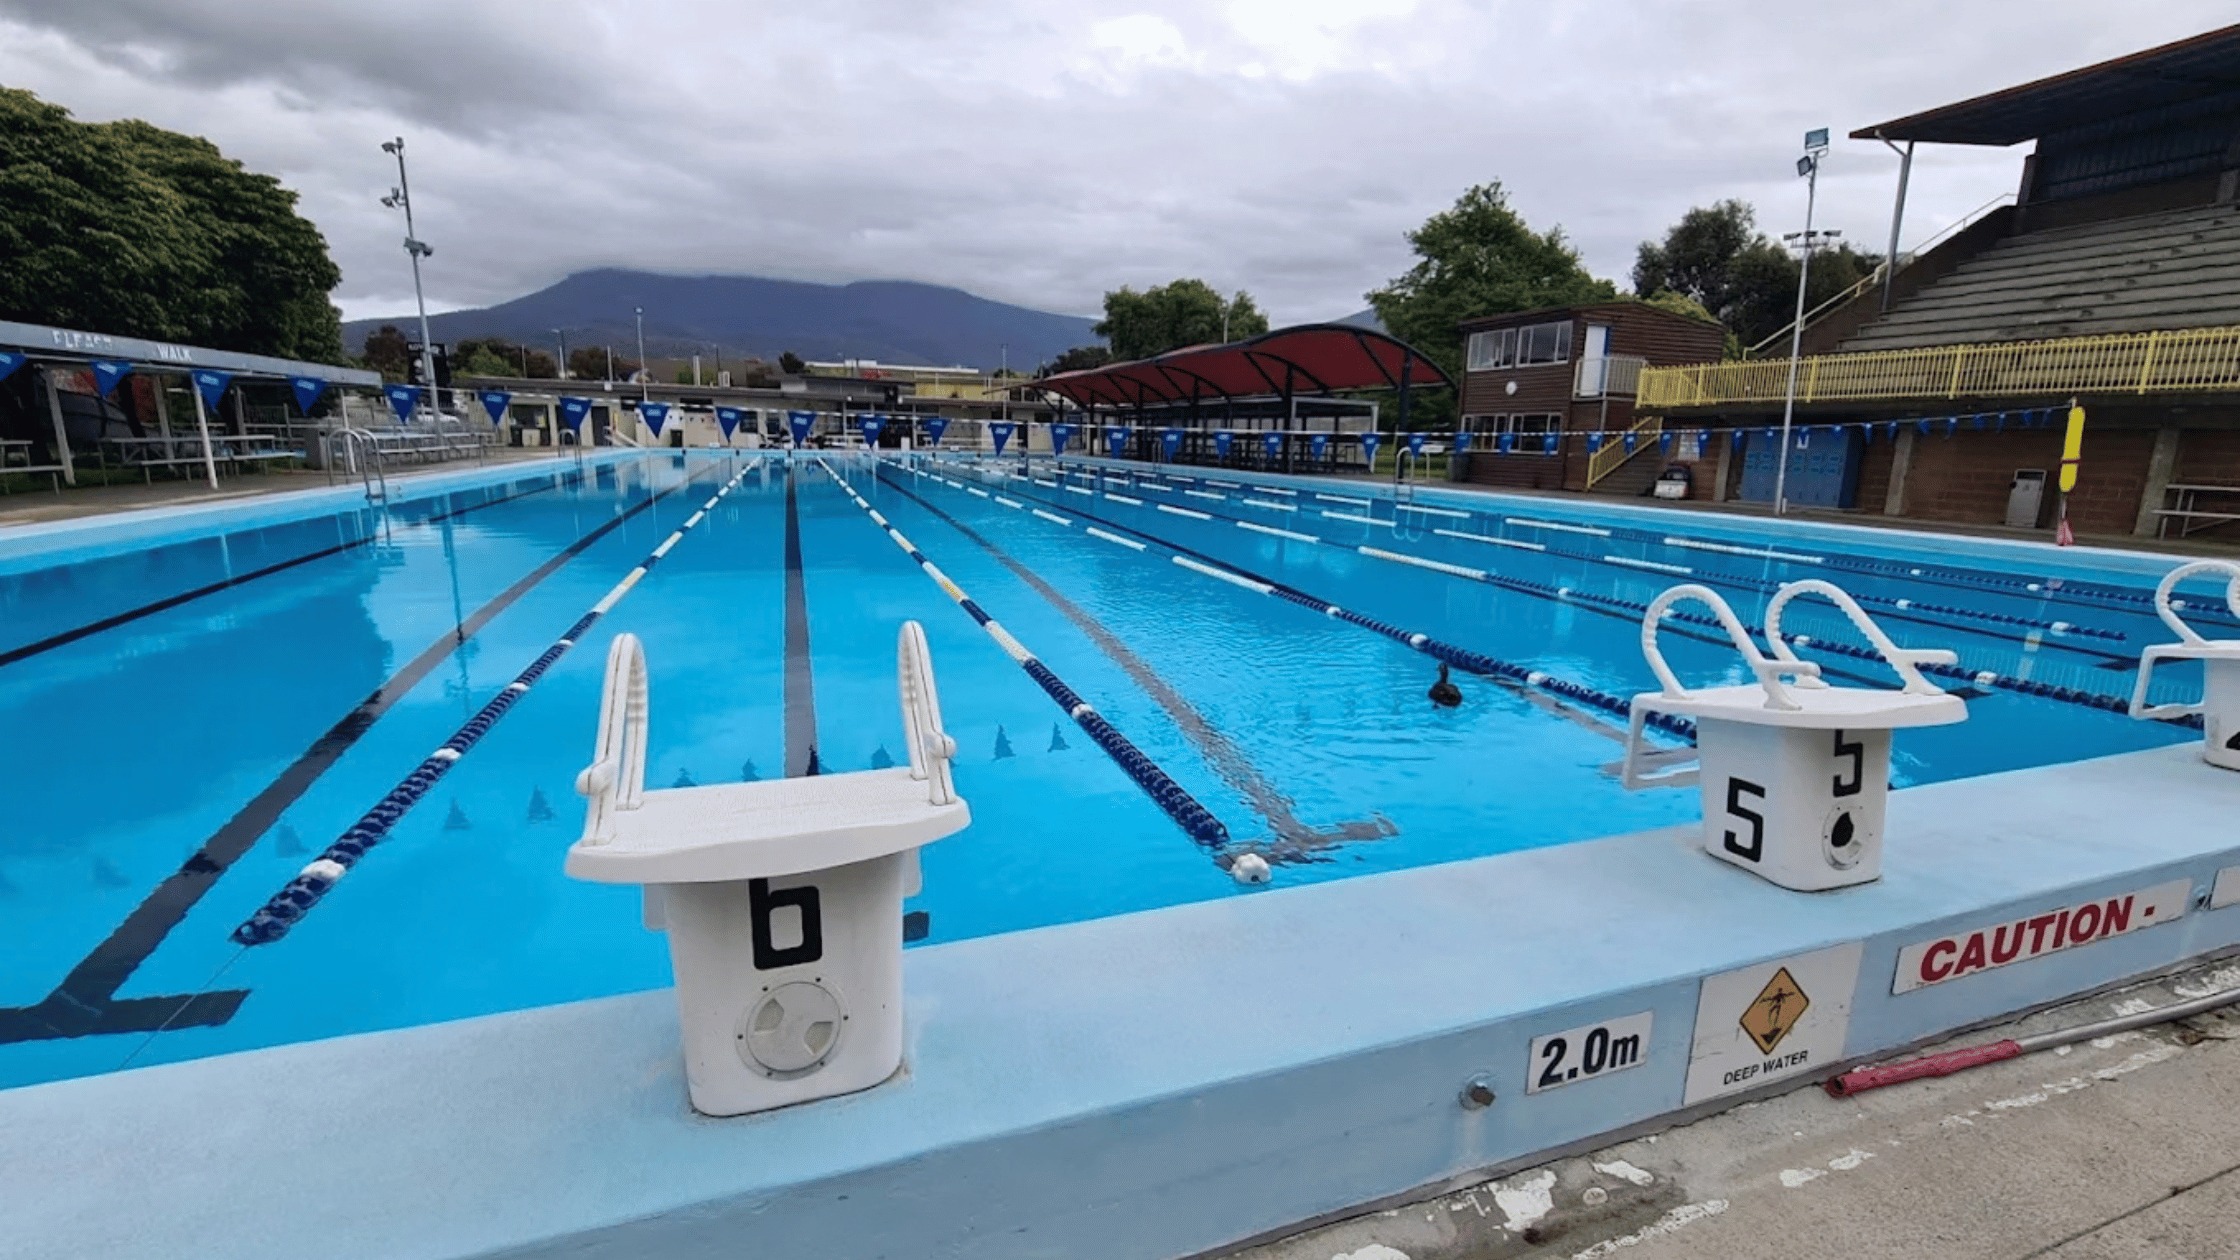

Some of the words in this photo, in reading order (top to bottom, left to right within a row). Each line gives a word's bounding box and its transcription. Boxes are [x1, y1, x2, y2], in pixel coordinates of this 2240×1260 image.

[156, 343, 193, 361] WALK
[1833, 728, 1864, 798] 5
[1724, 776, 1766, 863] 5
[1920, 895, 2135, 982] CAUTION
[1537, 1026, 1641, 1089] 2.0m
[1723, 1064, 1761, 1085] DEEP
[1763, 1050, 1809, 1073] WATER
